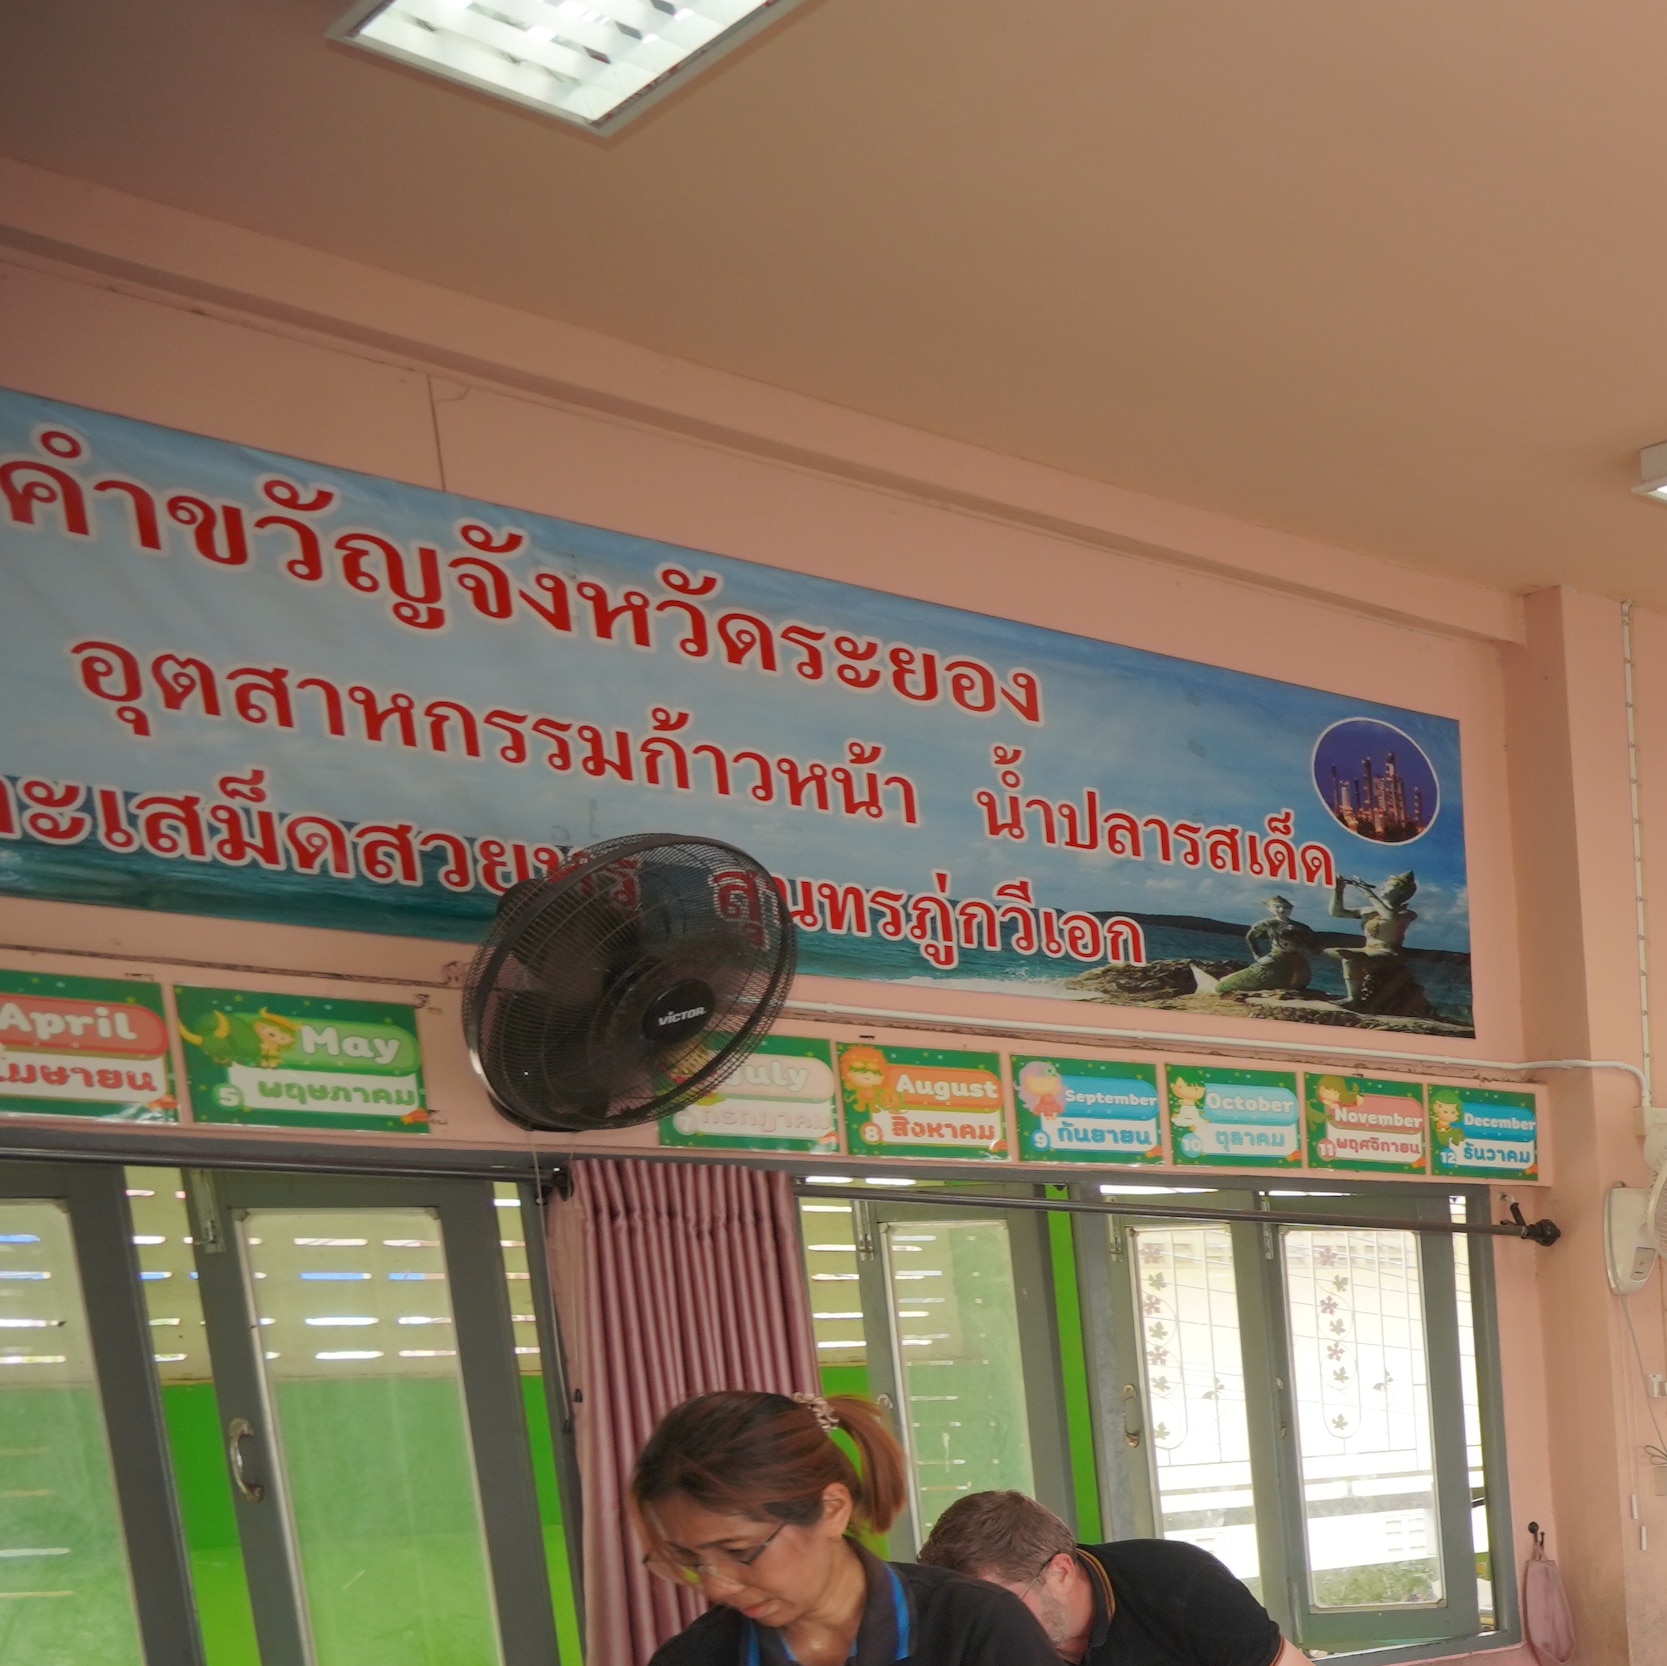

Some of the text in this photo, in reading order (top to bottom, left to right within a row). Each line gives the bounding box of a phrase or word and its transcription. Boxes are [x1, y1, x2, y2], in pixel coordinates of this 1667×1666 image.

[0, 430, 1042, 724] คำขวัญจังหวัดระยอง
[71, 638, 1335, 886] อุตสาหกรรมก้าวหน้า น้ำปลารสเด็ด
[0, 1002, 138, 1041] April
[302, 1025, 400, 1064] May
[218, 1087, 238, 1107] 5
[258, 1080, 416, 1108] พฤษภาคม
[896, 1074, 999, 1099] August
[1064, 1089, 1158, 1108] September
[1207, 1092, 1294, 1113] October
[678, 1115, 694, 1132] 7
[702, 1110, 831, 1133] กรกฎาคม
[892, 1116, 995, 1140] สิงหาคม
[1334, 1108, 1423, 1128] November
[1463, 1113, 1536, 1132] December
[865, 1126, 877, 1141] 8
[1034, 1130, 1044, 1146] 9
[1057, 1121, 1152, 1145] กันยายน
[1183, 1134, 1201, 1150] 10
[1215, 1129, 1285, 1152] ตุลาคม
[1319, 1143, 1335, 1157] 11
[1336, 1136, 1421, 1157] พฤศจิกายน
[1463, 1142, 1531, 1164] ธันวาคม
[1440, 1151, 1457, 1164] 12
